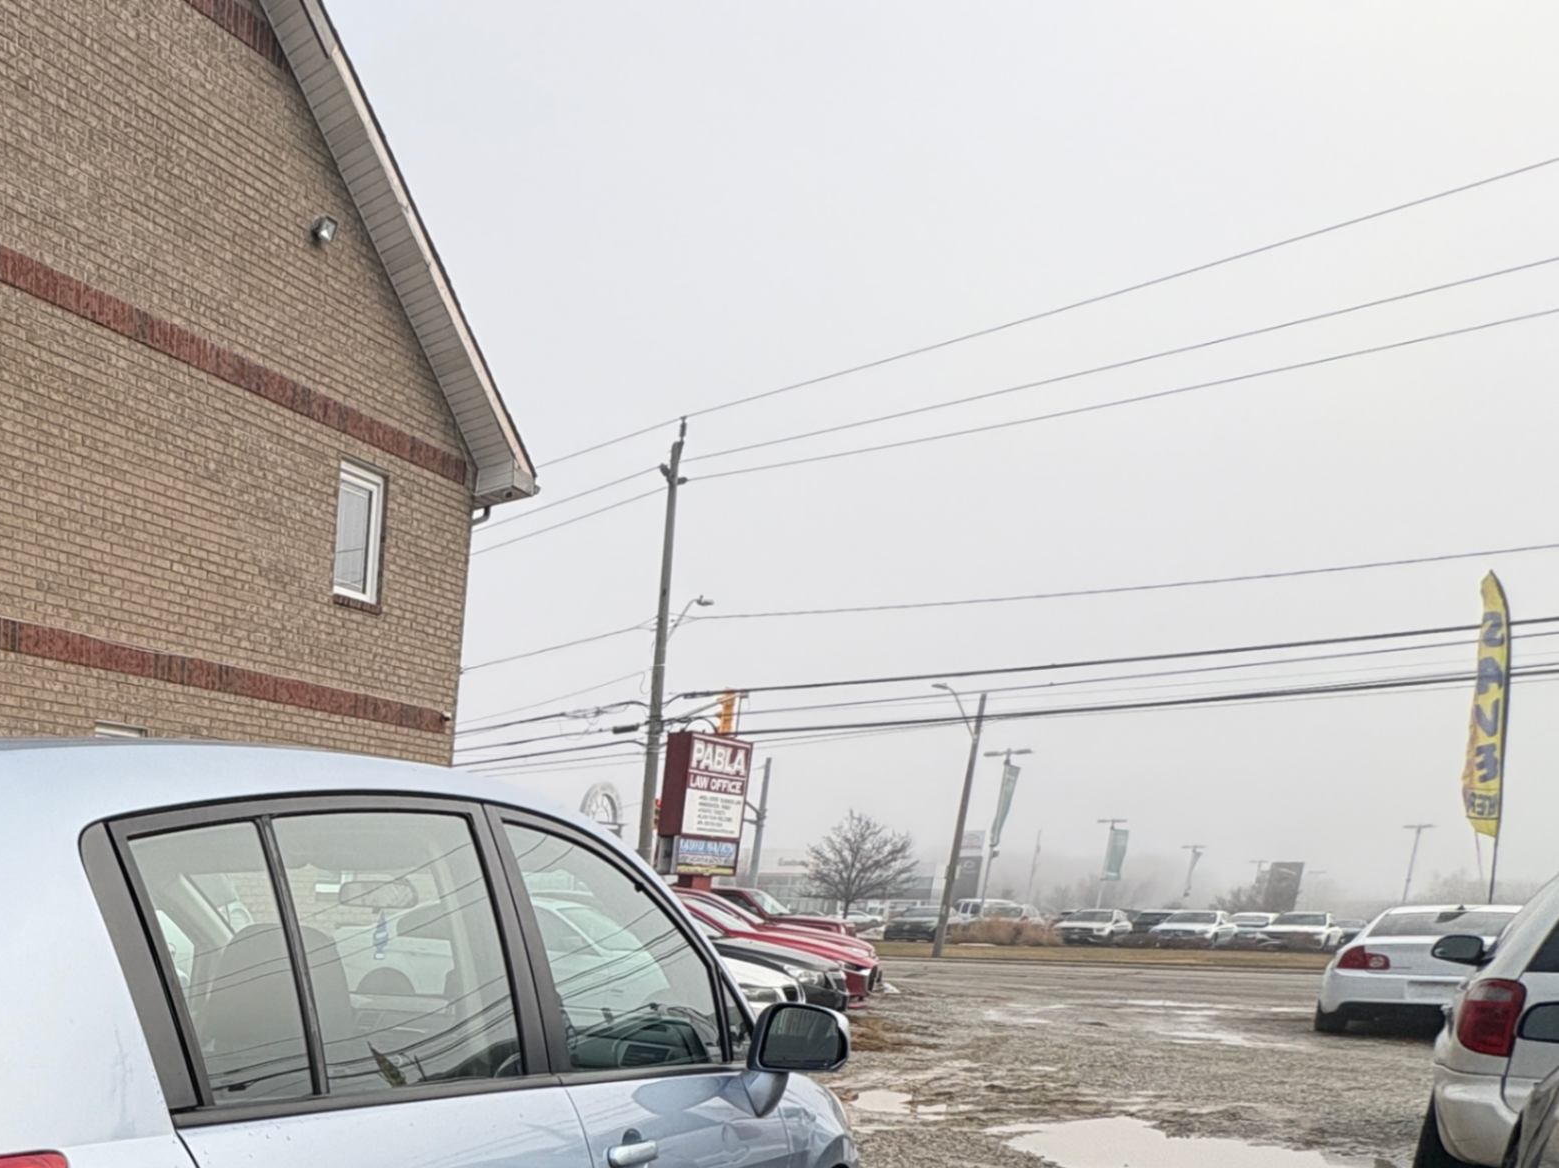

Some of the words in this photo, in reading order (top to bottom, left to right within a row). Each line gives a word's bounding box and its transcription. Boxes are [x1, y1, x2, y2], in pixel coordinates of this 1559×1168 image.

[690, 739, 746, 776] PABLA
[689, 773, 710, 789] LAW
[710, 778, 743, 794] OFFICE
